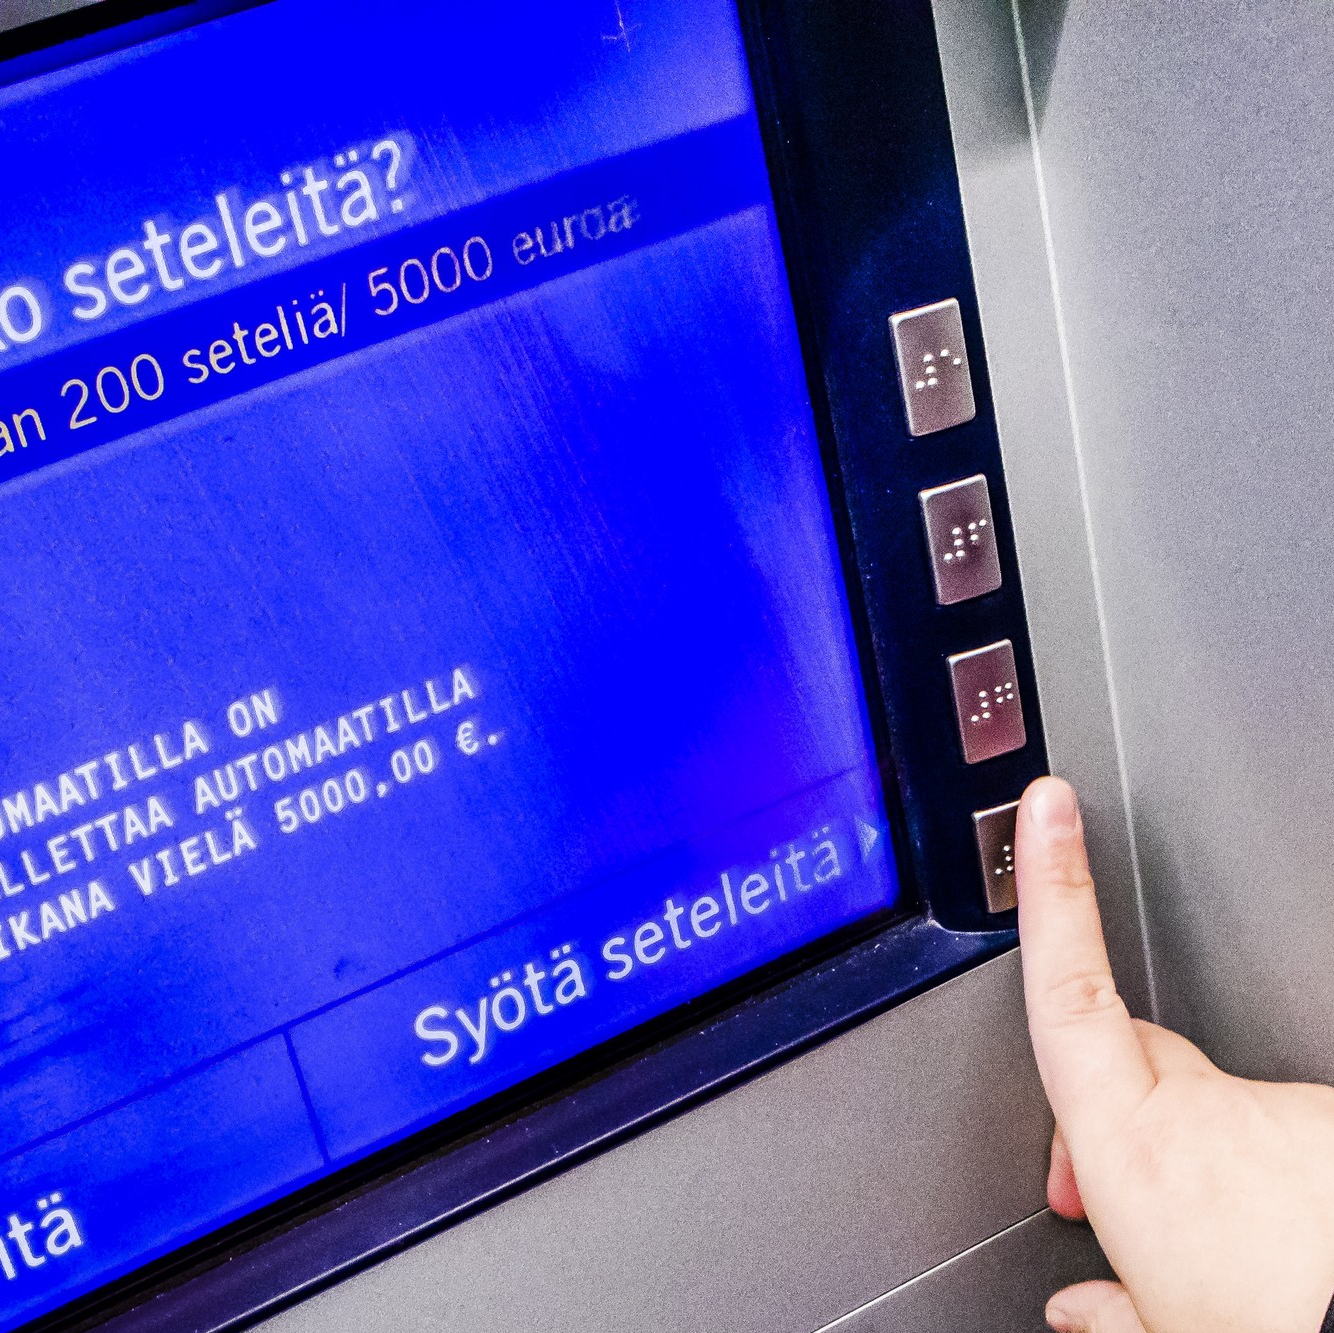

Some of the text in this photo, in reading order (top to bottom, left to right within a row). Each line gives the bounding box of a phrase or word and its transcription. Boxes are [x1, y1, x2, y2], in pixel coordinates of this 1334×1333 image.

[63, 138, 414, 319] seteleitä?
[61, 354, 163, 429] 200
[368, 236, 494, 316] 5000
[195, 669, 474, 814] AUTOMAATILLA
[228, 690, 277, 737] ON
[129, 810, 256, 895] VIELÄ
[275, 740, 434, 833] 5000,00
[414, 827, 841, 1066] Syötä seteleitä
